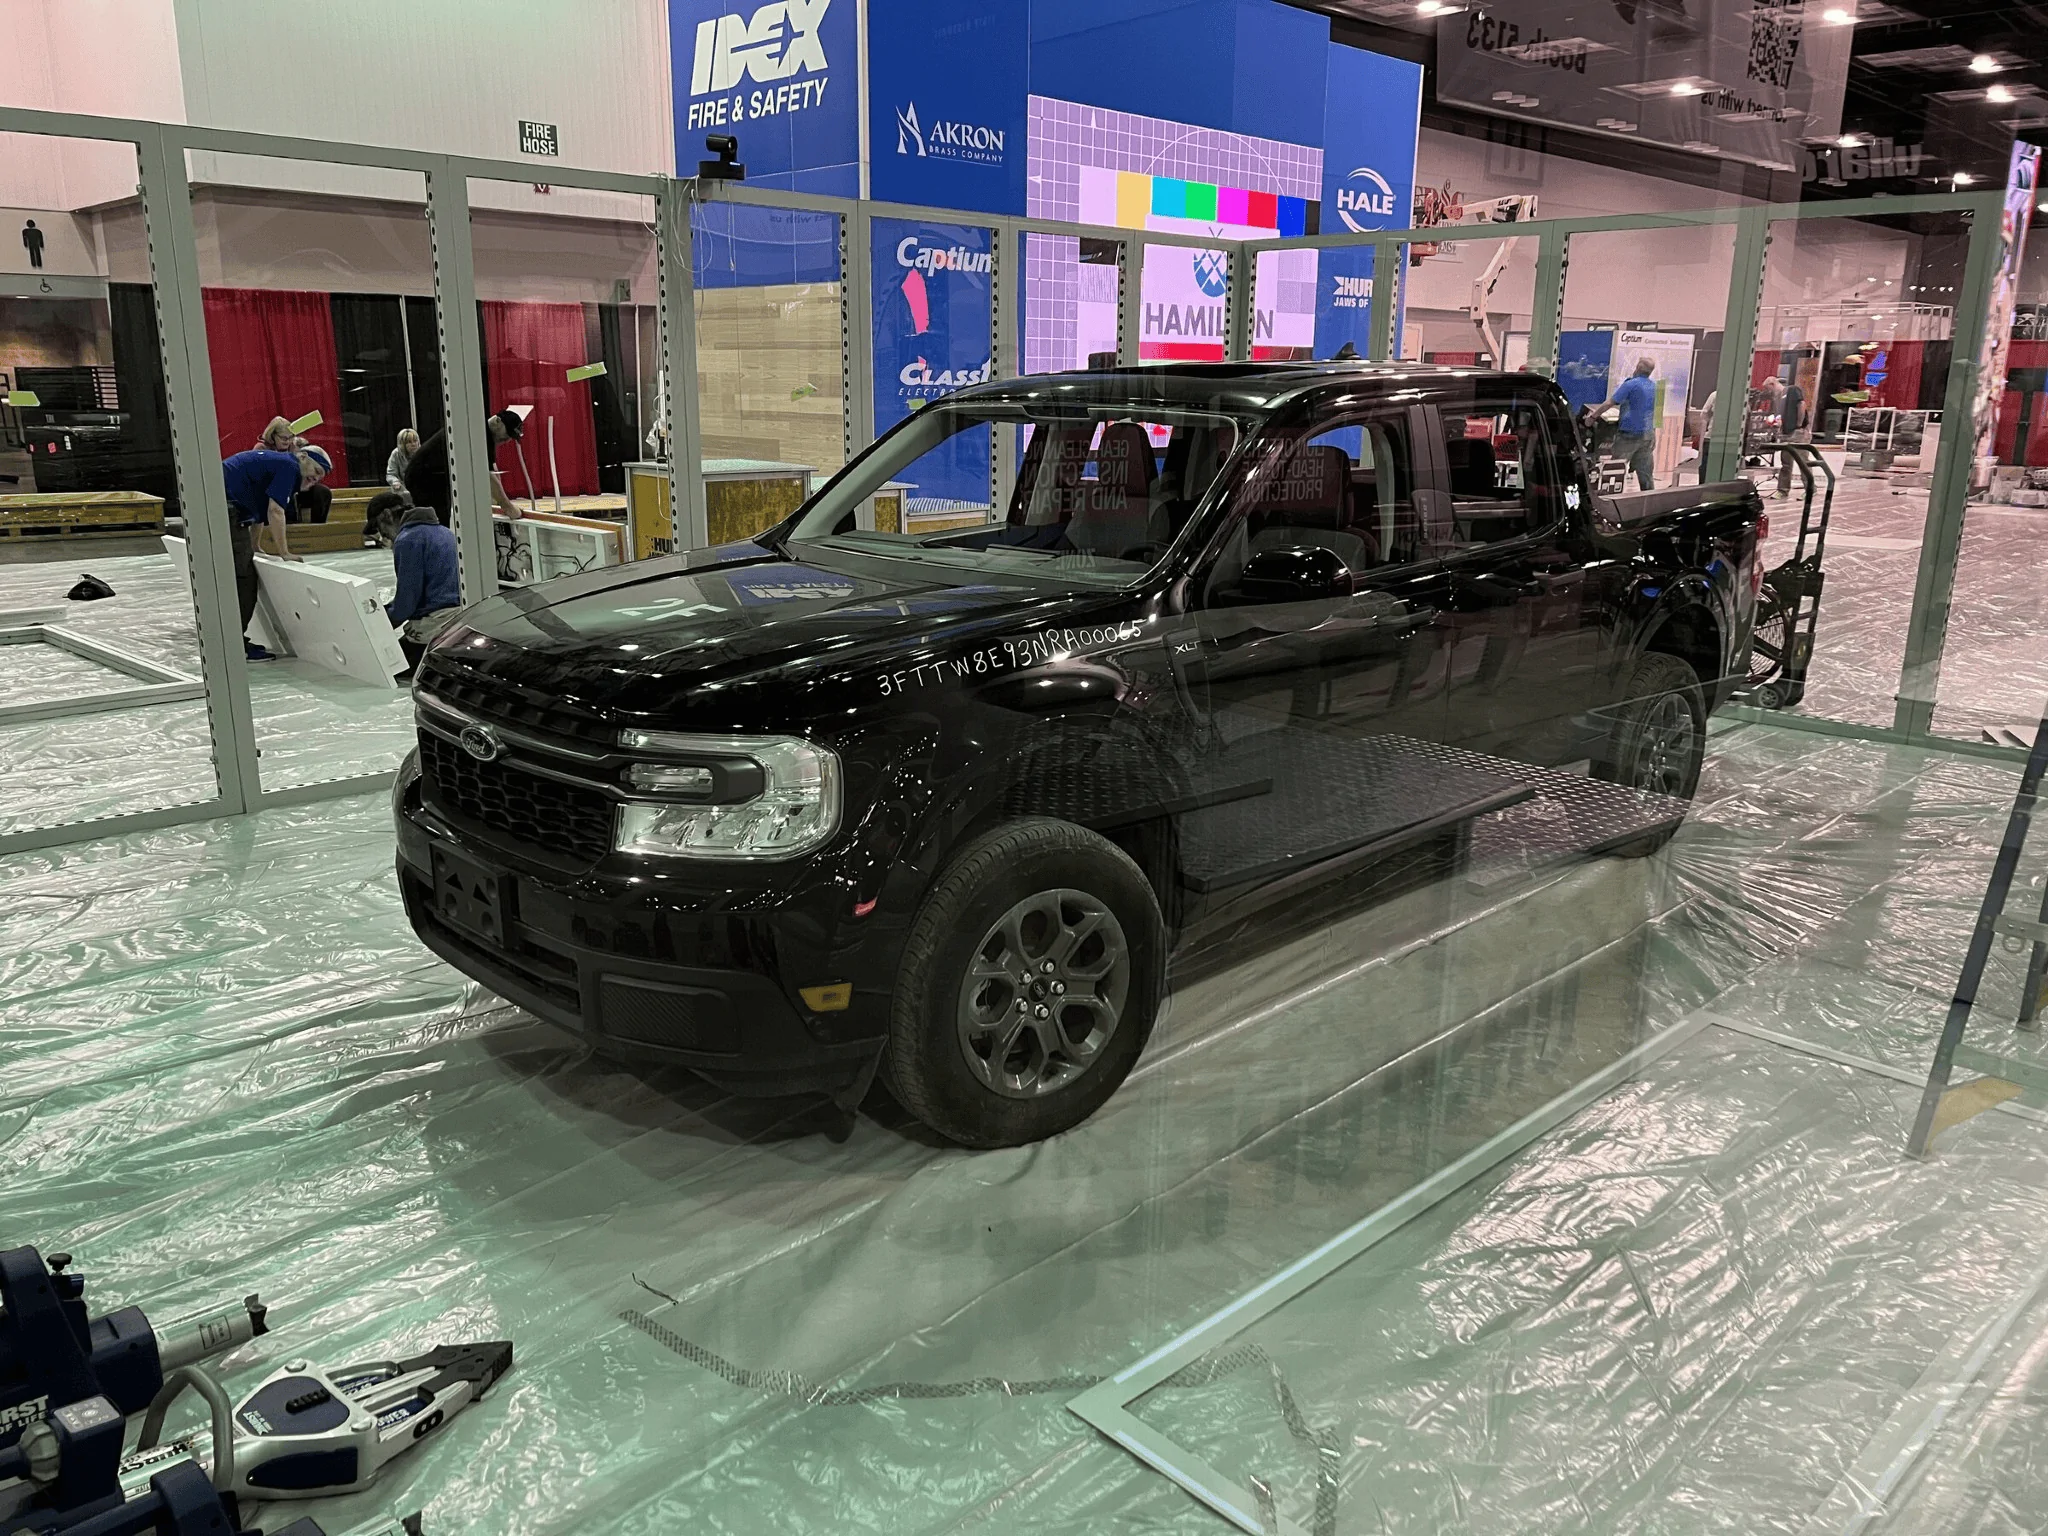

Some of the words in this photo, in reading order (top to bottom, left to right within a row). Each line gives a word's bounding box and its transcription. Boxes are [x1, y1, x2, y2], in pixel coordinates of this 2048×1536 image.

[690, 0, 831, 97] IDEX
[687, 97, 729, 131] FIRE
[731, 95, 744, 123] &
[749, 77, 829, 120] SAFETY
[525, 122, 552, 140] FIRE
[930, 120, 1004, 152] AKRON
[523, 137, 556, 155] HOSE
[929, 145, 957, 157] BRASS
[961, 150, 1003, 163] COMPANY
[1337, 189, 1394, 215] HALE
[1333, 298, 1356, 308] JAWS
[1358, 298, 1369, 309] OF
[1145, 302, 1275, 340] HAMILN
[1175, 640, 1201, 655] XLT
[0, 1394, 49, 1425] RST
[18, 1411, 46, 1428] LIFE
